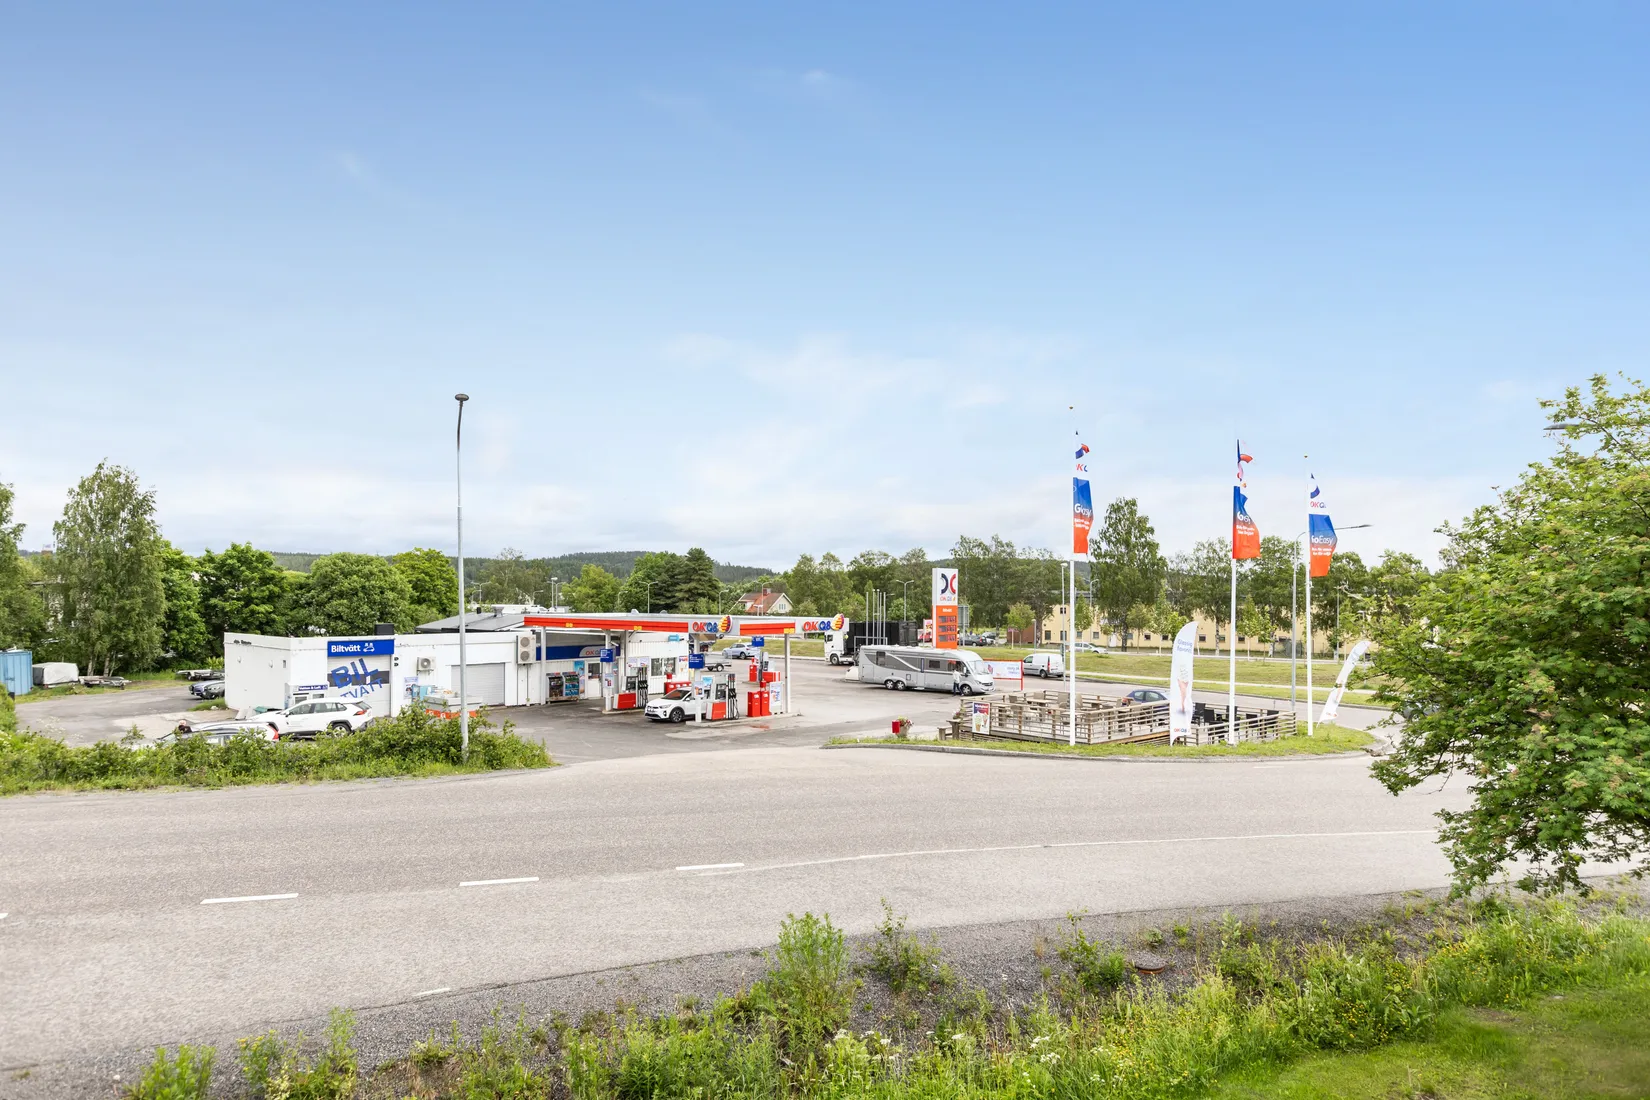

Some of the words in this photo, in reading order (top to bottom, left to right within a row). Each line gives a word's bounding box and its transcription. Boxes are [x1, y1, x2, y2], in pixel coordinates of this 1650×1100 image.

[692, 621, 718, 633] OKQ8
[803, 620, 831, 631] OKQ8
[331, 644, 361, 653] Biltvätt
[331, 658, 379, 689] BIL
